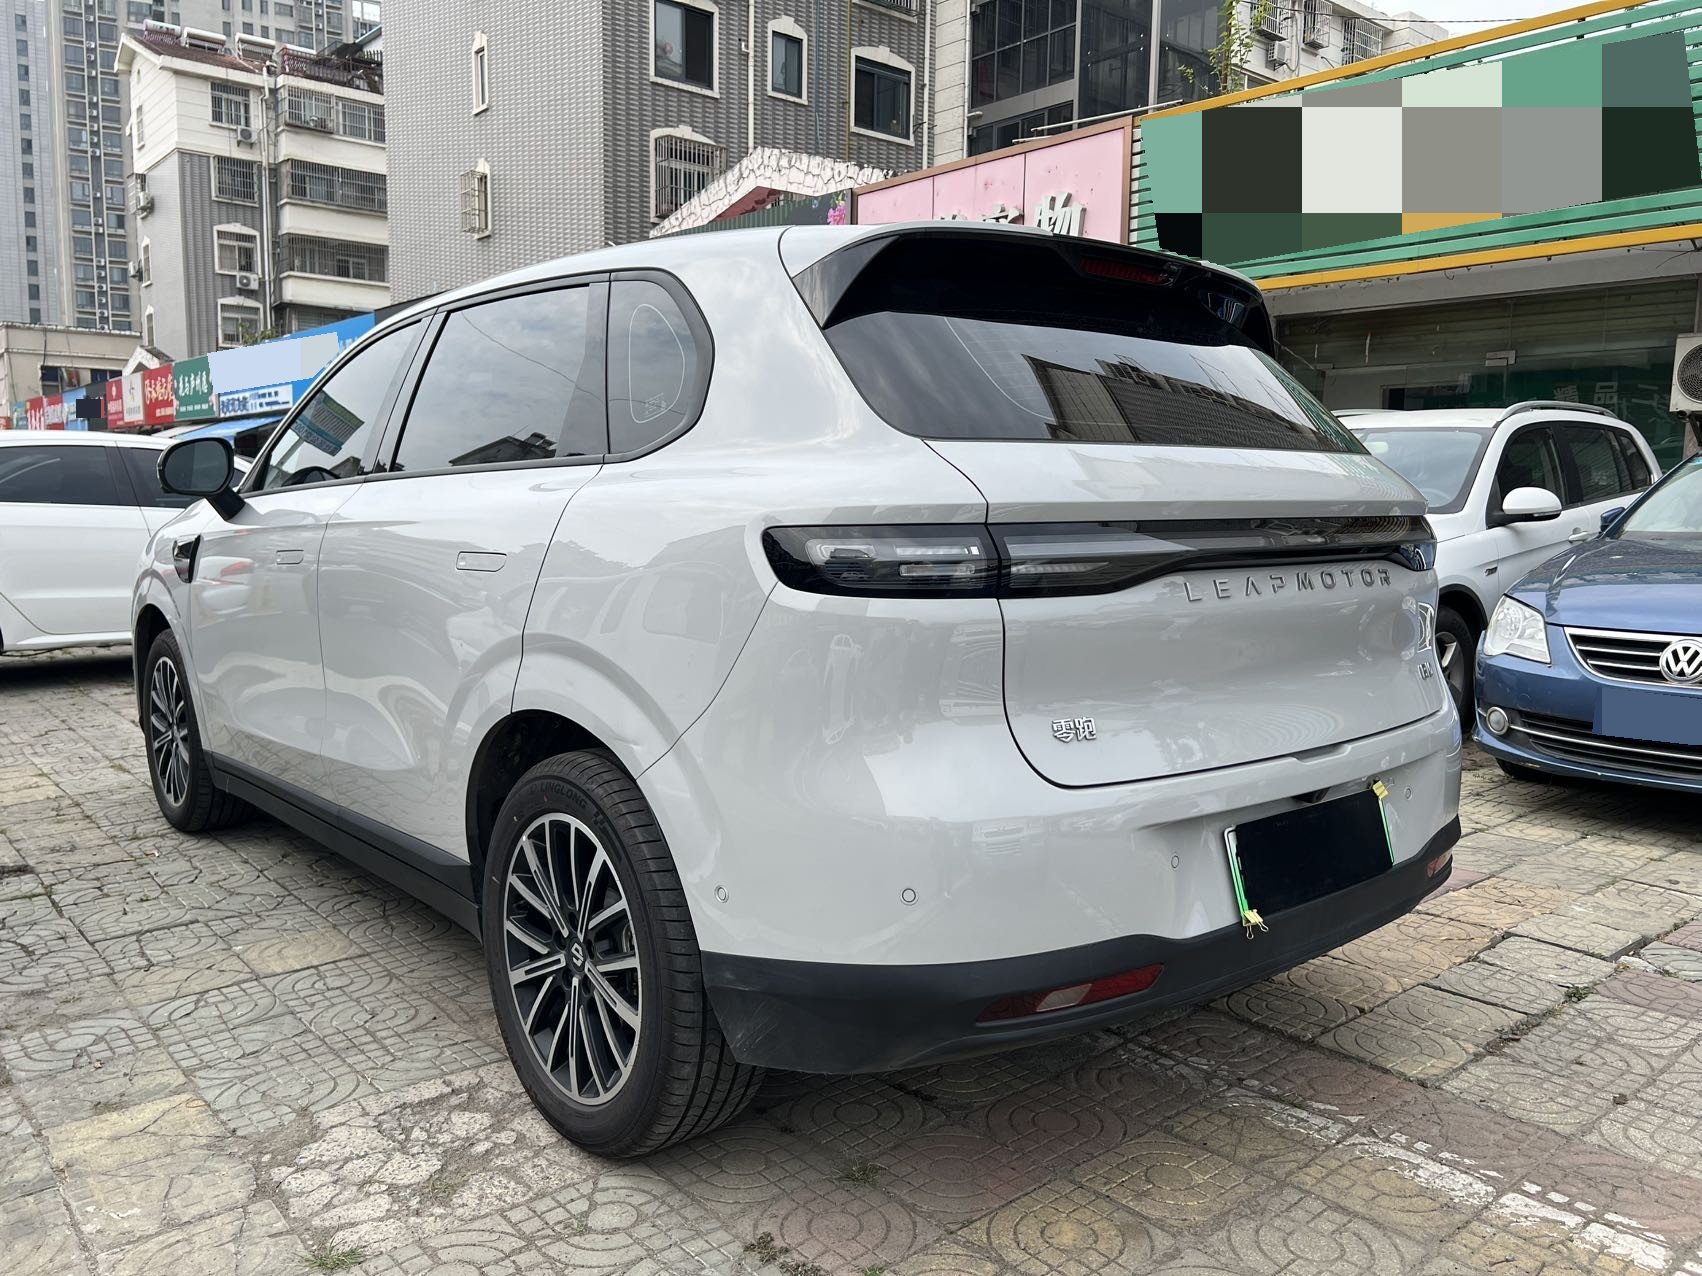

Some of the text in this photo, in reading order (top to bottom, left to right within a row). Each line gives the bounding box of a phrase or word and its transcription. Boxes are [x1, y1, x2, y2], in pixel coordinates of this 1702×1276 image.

[1183, 568, 1393, 602] LEAPMOTOR
[1052, 716, 1097, 743] 零跑
[540, 782, 588, 809] LINGLONG
